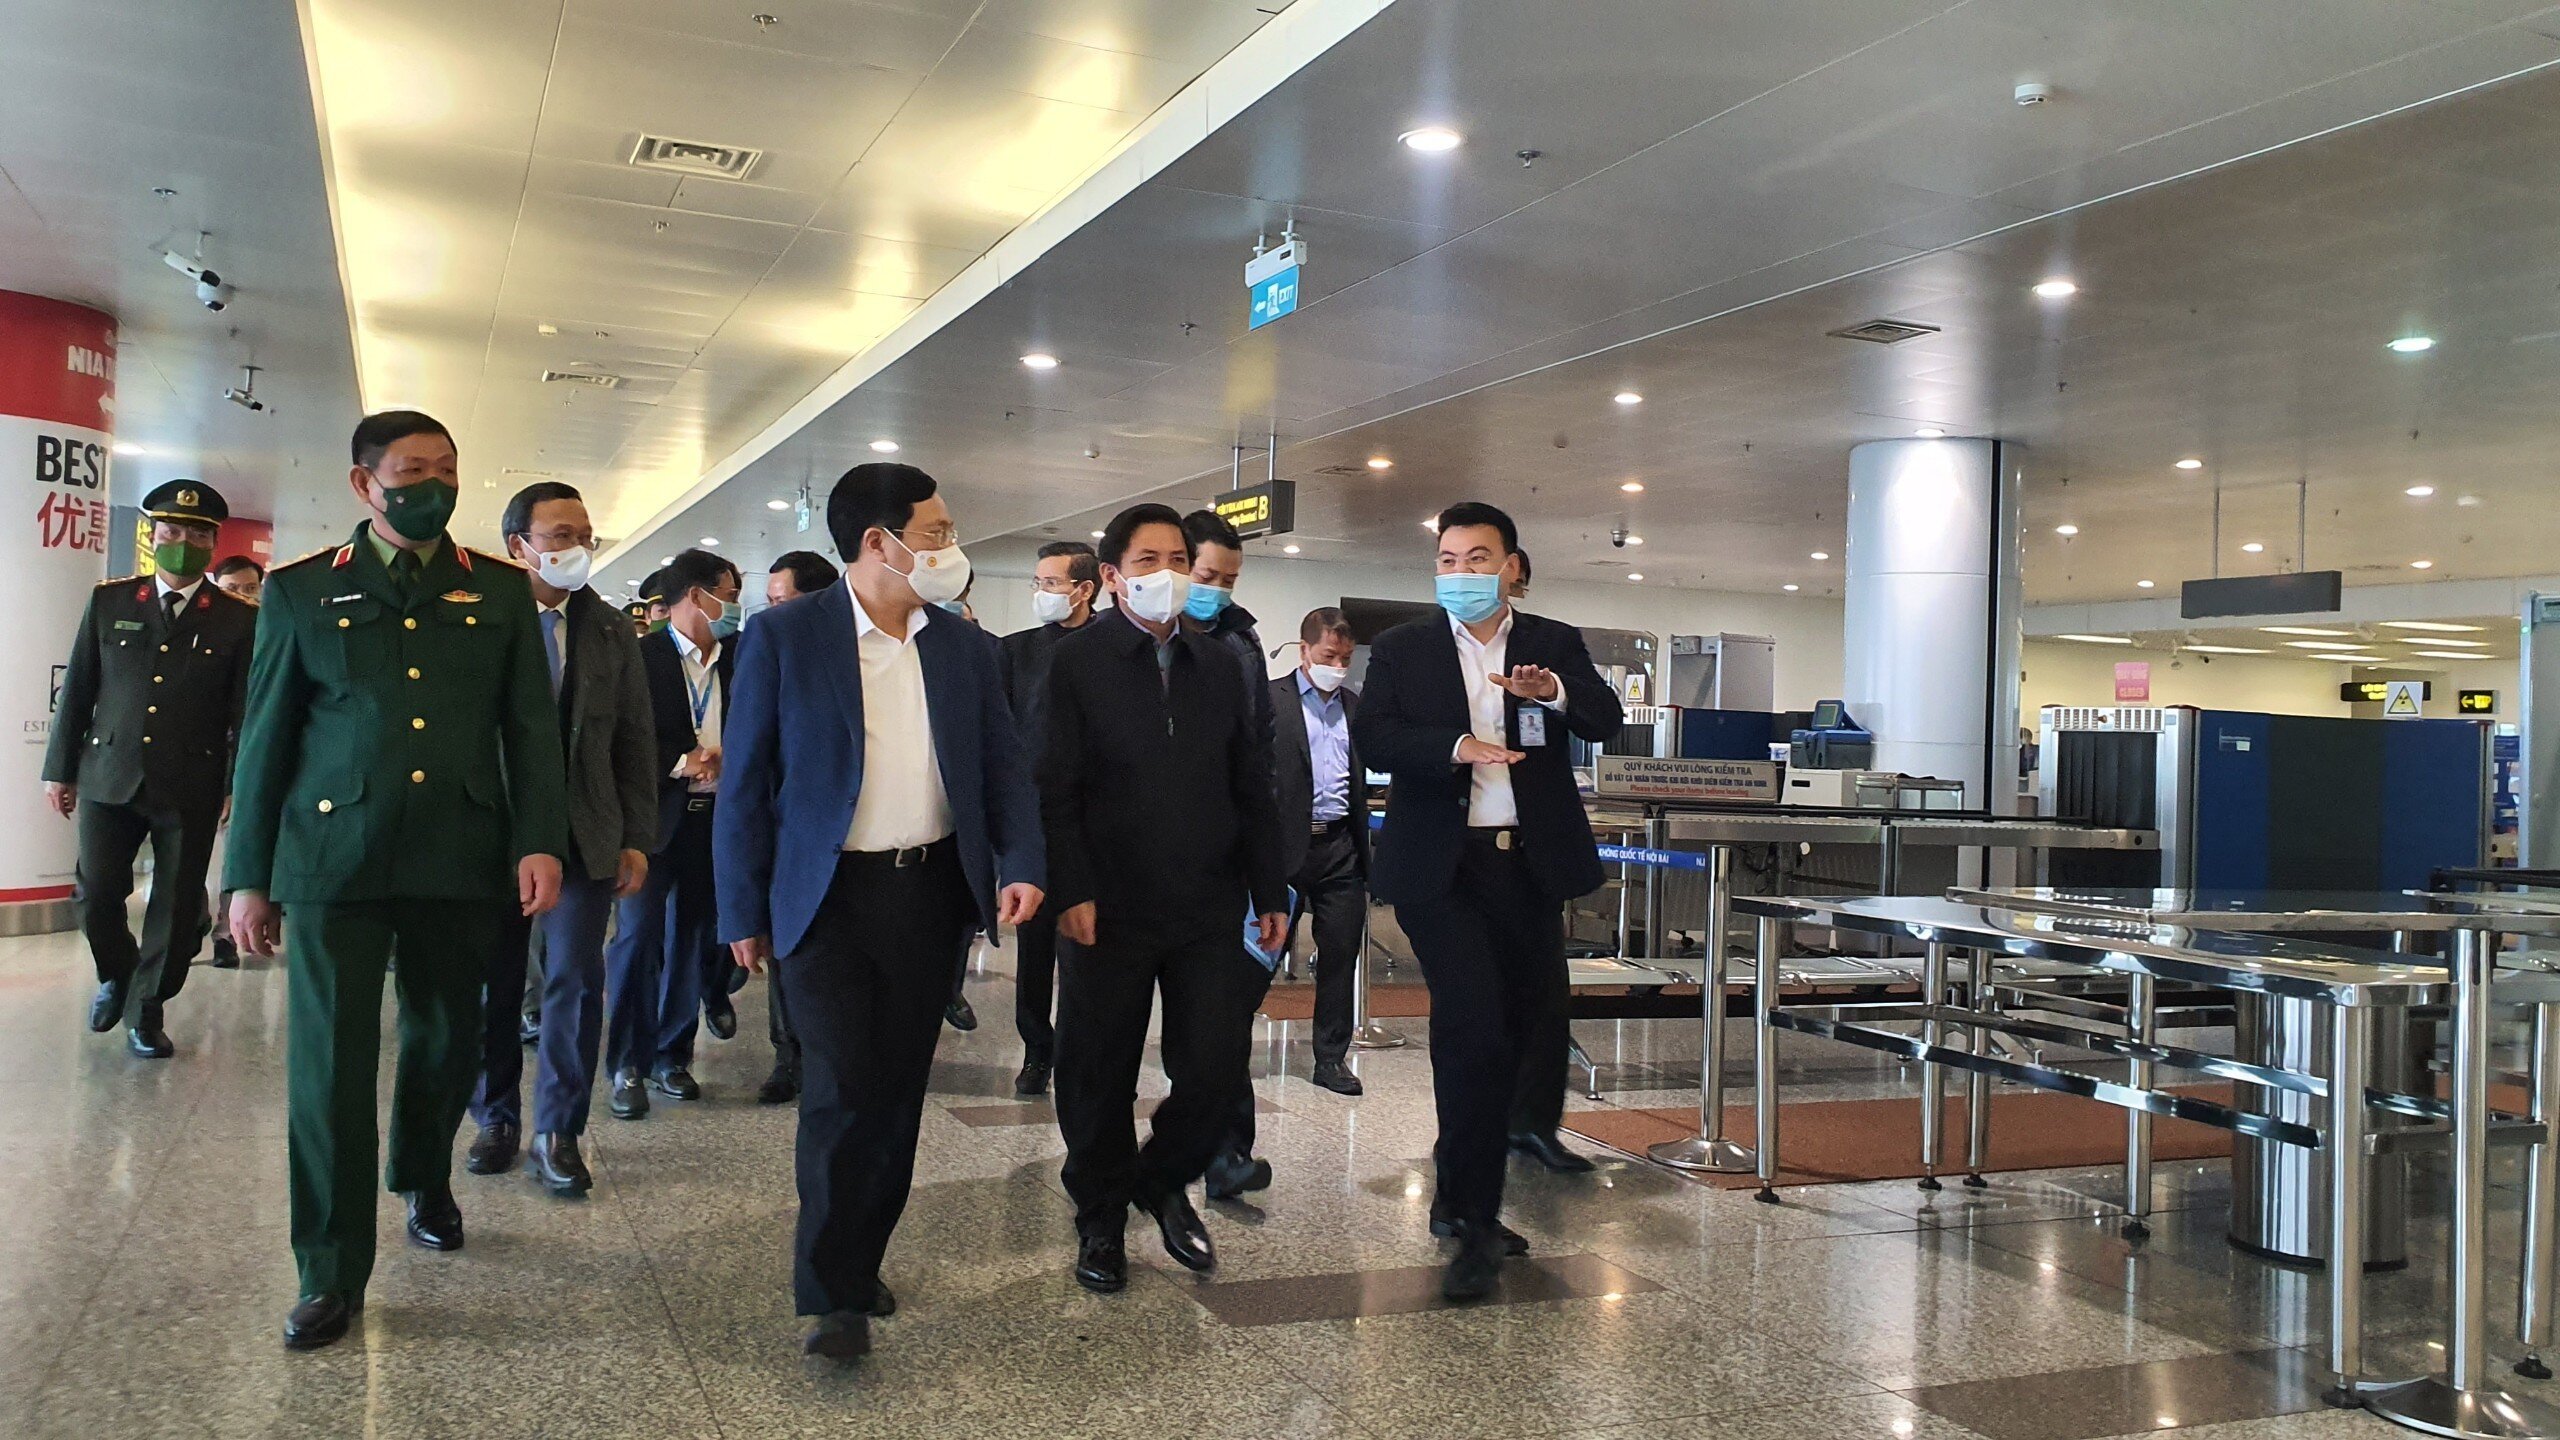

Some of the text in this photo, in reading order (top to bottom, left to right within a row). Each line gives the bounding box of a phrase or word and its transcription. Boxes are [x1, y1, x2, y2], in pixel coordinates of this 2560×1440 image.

[1258, 495, 1268, 520] B
[1644, 762, 1673, 772] KHÁCH
[1674, 764, 1689, 773] VUI
[1690, 763, 1713, 774] LÒNG
[1714, 763, 1734, 775] KIỂM
[1734, 766, 1752, 775] TRA
